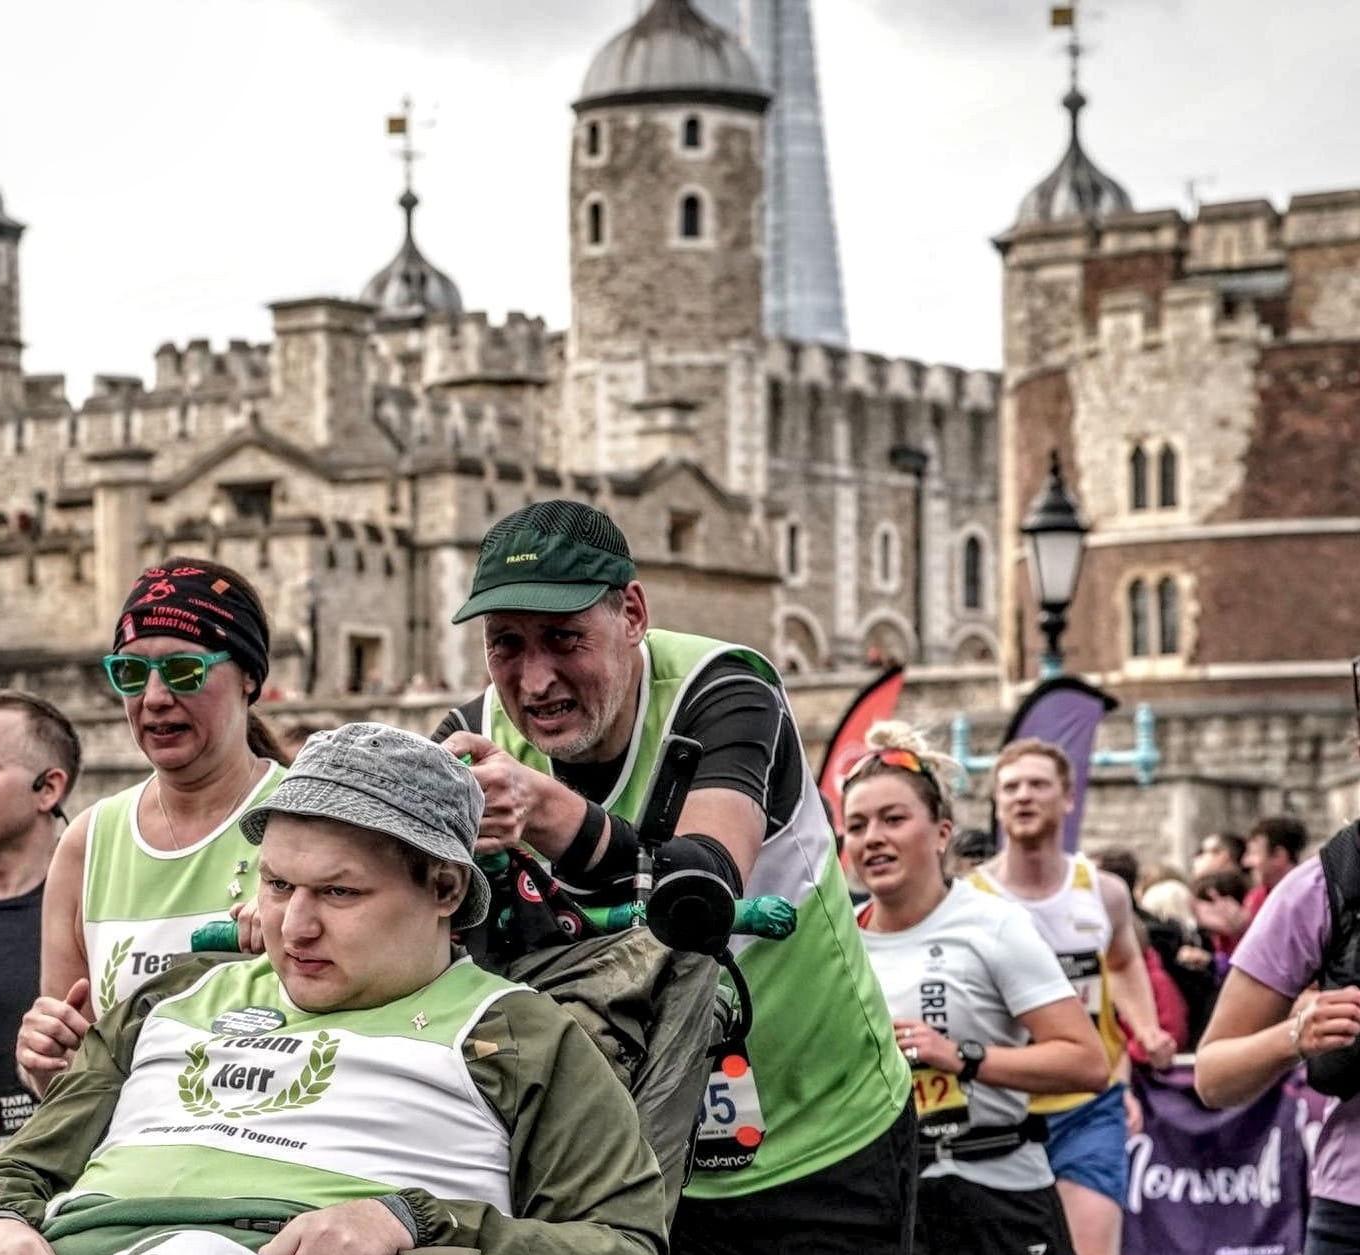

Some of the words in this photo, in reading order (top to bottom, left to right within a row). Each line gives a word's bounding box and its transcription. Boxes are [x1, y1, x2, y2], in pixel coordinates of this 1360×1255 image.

[152, 606, 200, 622] LONDON
[142, 617, 202, 636] MARATHON
[132, 952, 174, 975] Tea
[212, 1064, 275, 1093] Kerr
[241, 1128, 307, 1150] Together
[696, 1153, 755, 1169] balance
